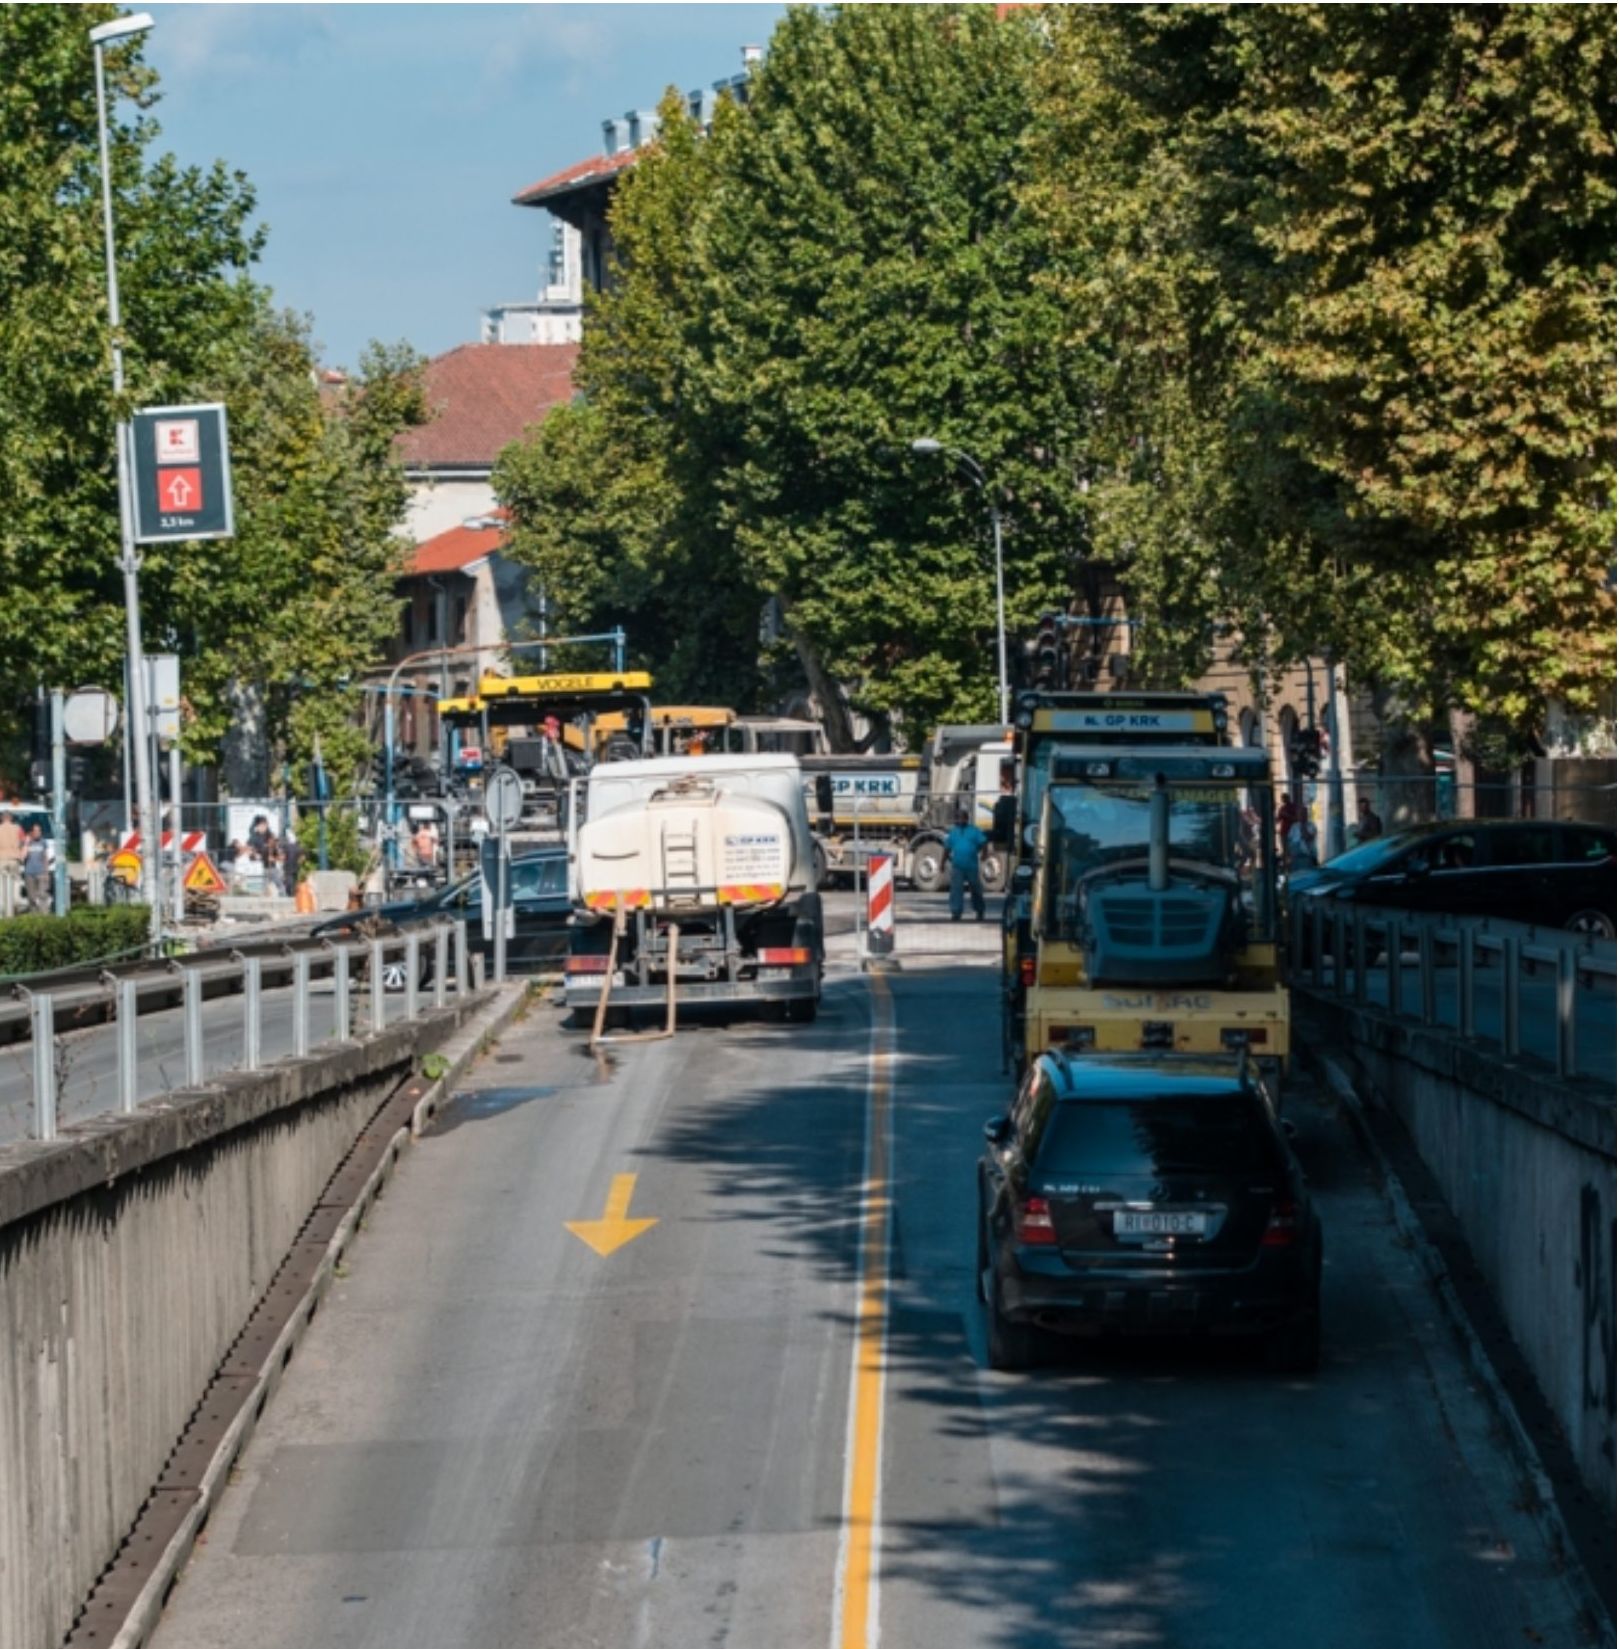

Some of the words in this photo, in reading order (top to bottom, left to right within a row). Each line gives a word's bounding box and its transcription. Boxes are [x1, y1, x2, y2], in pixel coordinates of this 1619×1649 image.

[1105, 715, 1126, 726] GP
[1129, 715, 1160, 727] KRK
[854, 780, 894, 793] KRK
